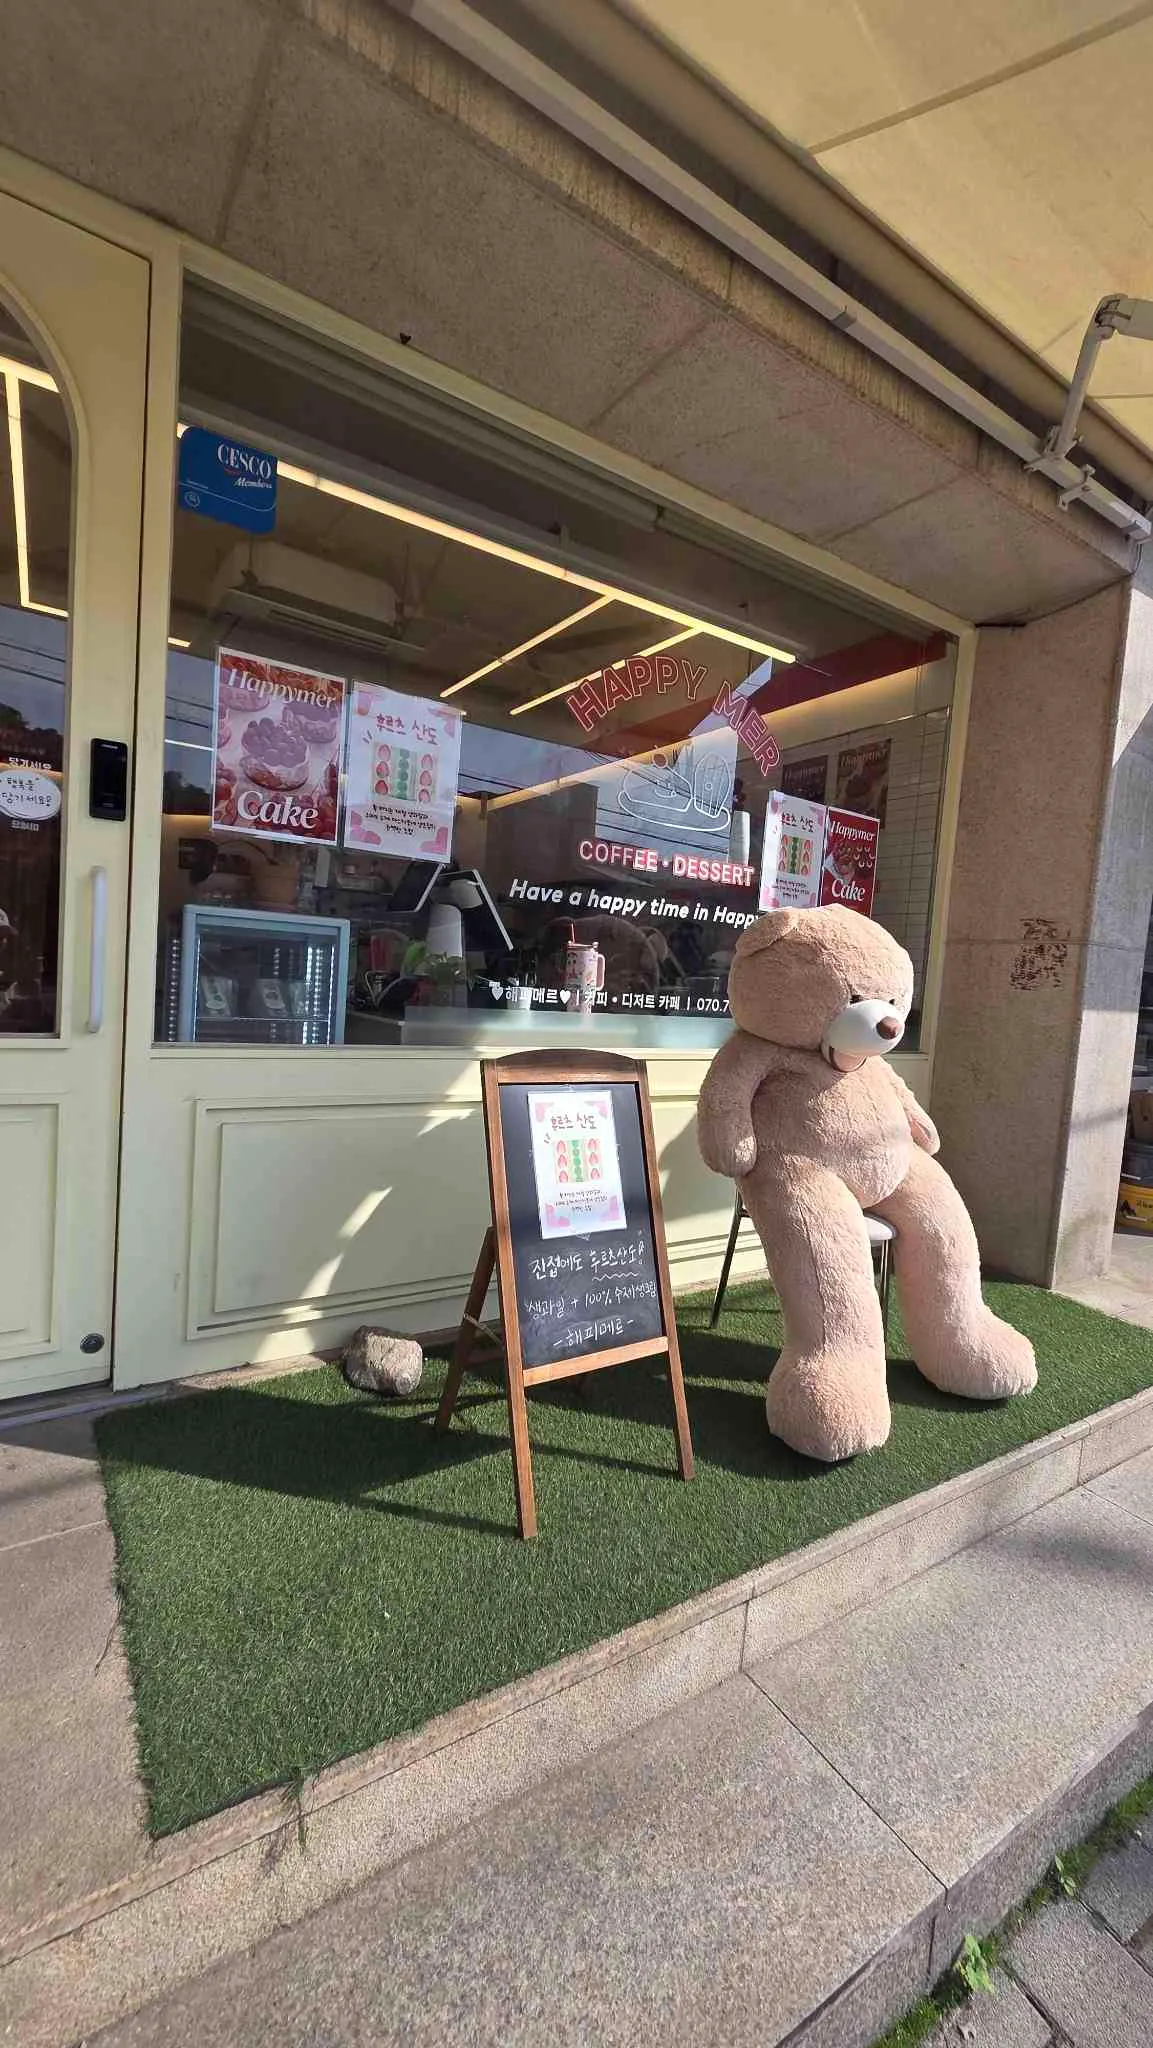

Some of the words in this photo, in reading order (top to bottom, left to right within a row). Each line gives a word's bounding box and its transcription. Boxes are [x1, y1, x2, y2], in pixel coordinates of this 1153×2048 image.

[218, 442, 272, 480] CESCO
[228, 668, 337, 709] Happymer
[376, 713, 406, 735] 후르츠
[412, 719, 438, 745] 산도
[567, 656, 708, 733] HAPPY
[713, 680, 781, 777] MER
[237, 790, 319, 830] Cake
[831, 821, 876, 841] Happymer
[579, 841, 659, 872] COFFEE
[673, 854, 755, 888] DESSERT
[509, 878, 567, 904] Have
[569, 890, 582, 906] a
[587, 888, 647, 917] happy
[650, 899, 689, 919] time
[693, 903, 709, 921] in
[713, 905, 758, 930] Happ
[831, 879, 866, 902] Cake
[584, 989, 608, 1007] 커피
[622, 993, 655, 1009] 디저트
[659, 995, 680, 1011] 카페
[585, 1289, 612, 1308] 100%
